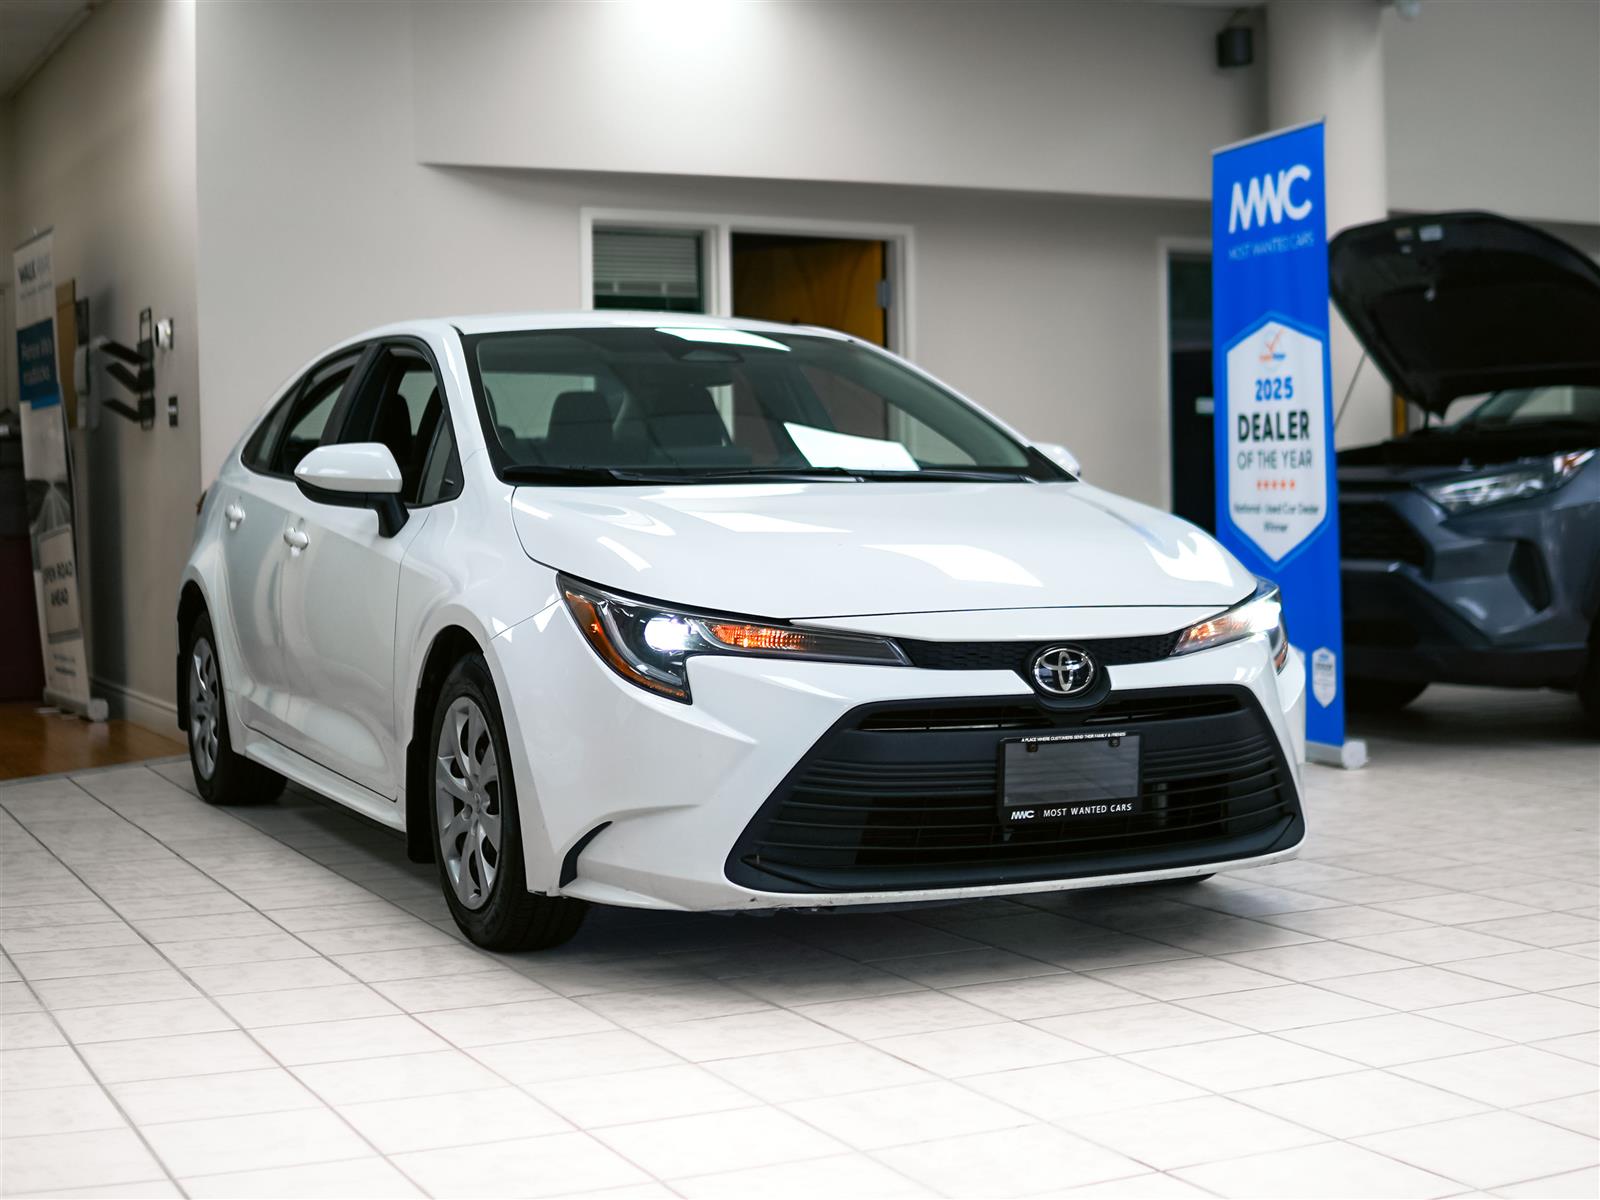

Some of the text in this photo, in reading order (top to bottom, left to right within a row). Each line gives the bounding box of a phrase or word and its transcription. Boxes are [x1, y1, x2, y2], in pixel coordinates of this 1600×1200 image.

[1255, 377, 1294, 401] 2025
[1237, 409, 1310, 443] DEALER
[1237, 449, 1313, 471] OF THE YEAR
[1043, 803, 1132, 818] MOST WANTED CARS
